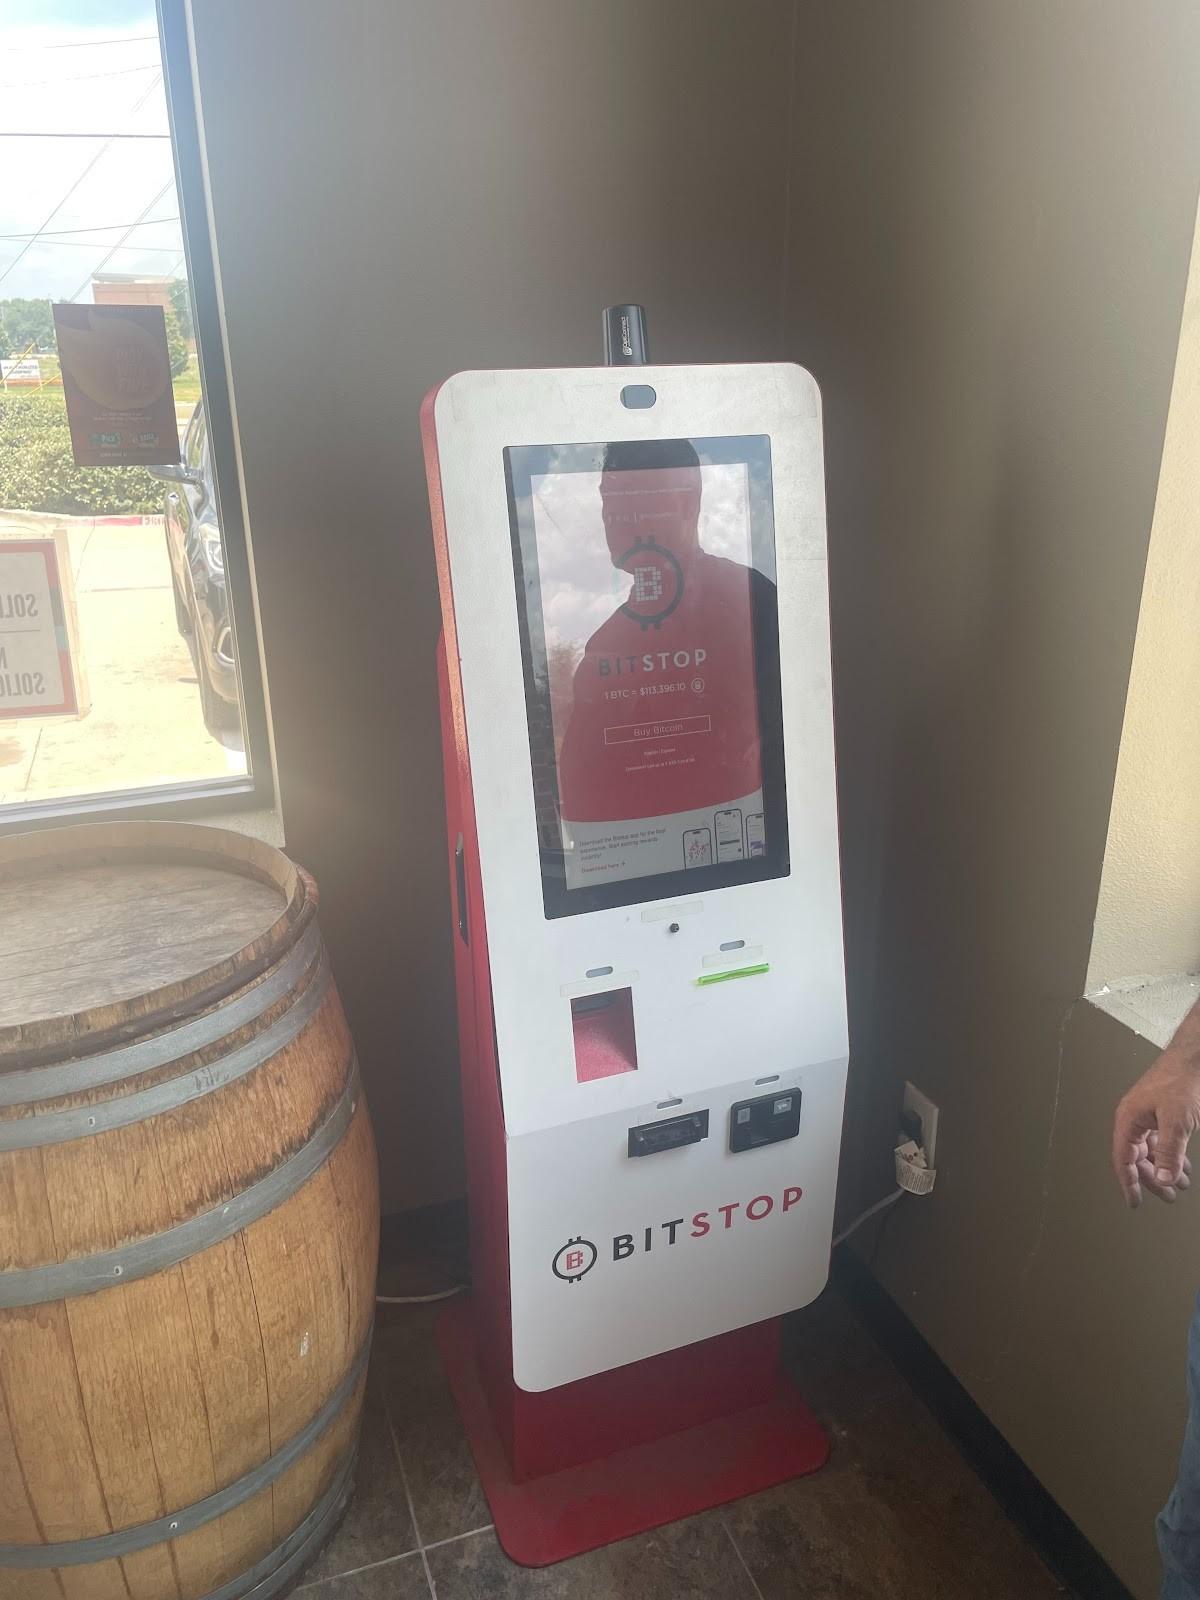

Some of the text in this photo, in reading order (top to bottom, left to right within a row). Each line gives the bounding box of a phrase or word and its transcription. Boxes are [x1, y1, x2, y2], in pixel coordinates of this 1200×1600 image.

[599, 649, 706, 676] BITSTOP
[610, 689, 630, 699] BTC
[633, 723, 684, 737] Buy Bitcoin
[613, 1187, 803, 1261] BITSTOP
